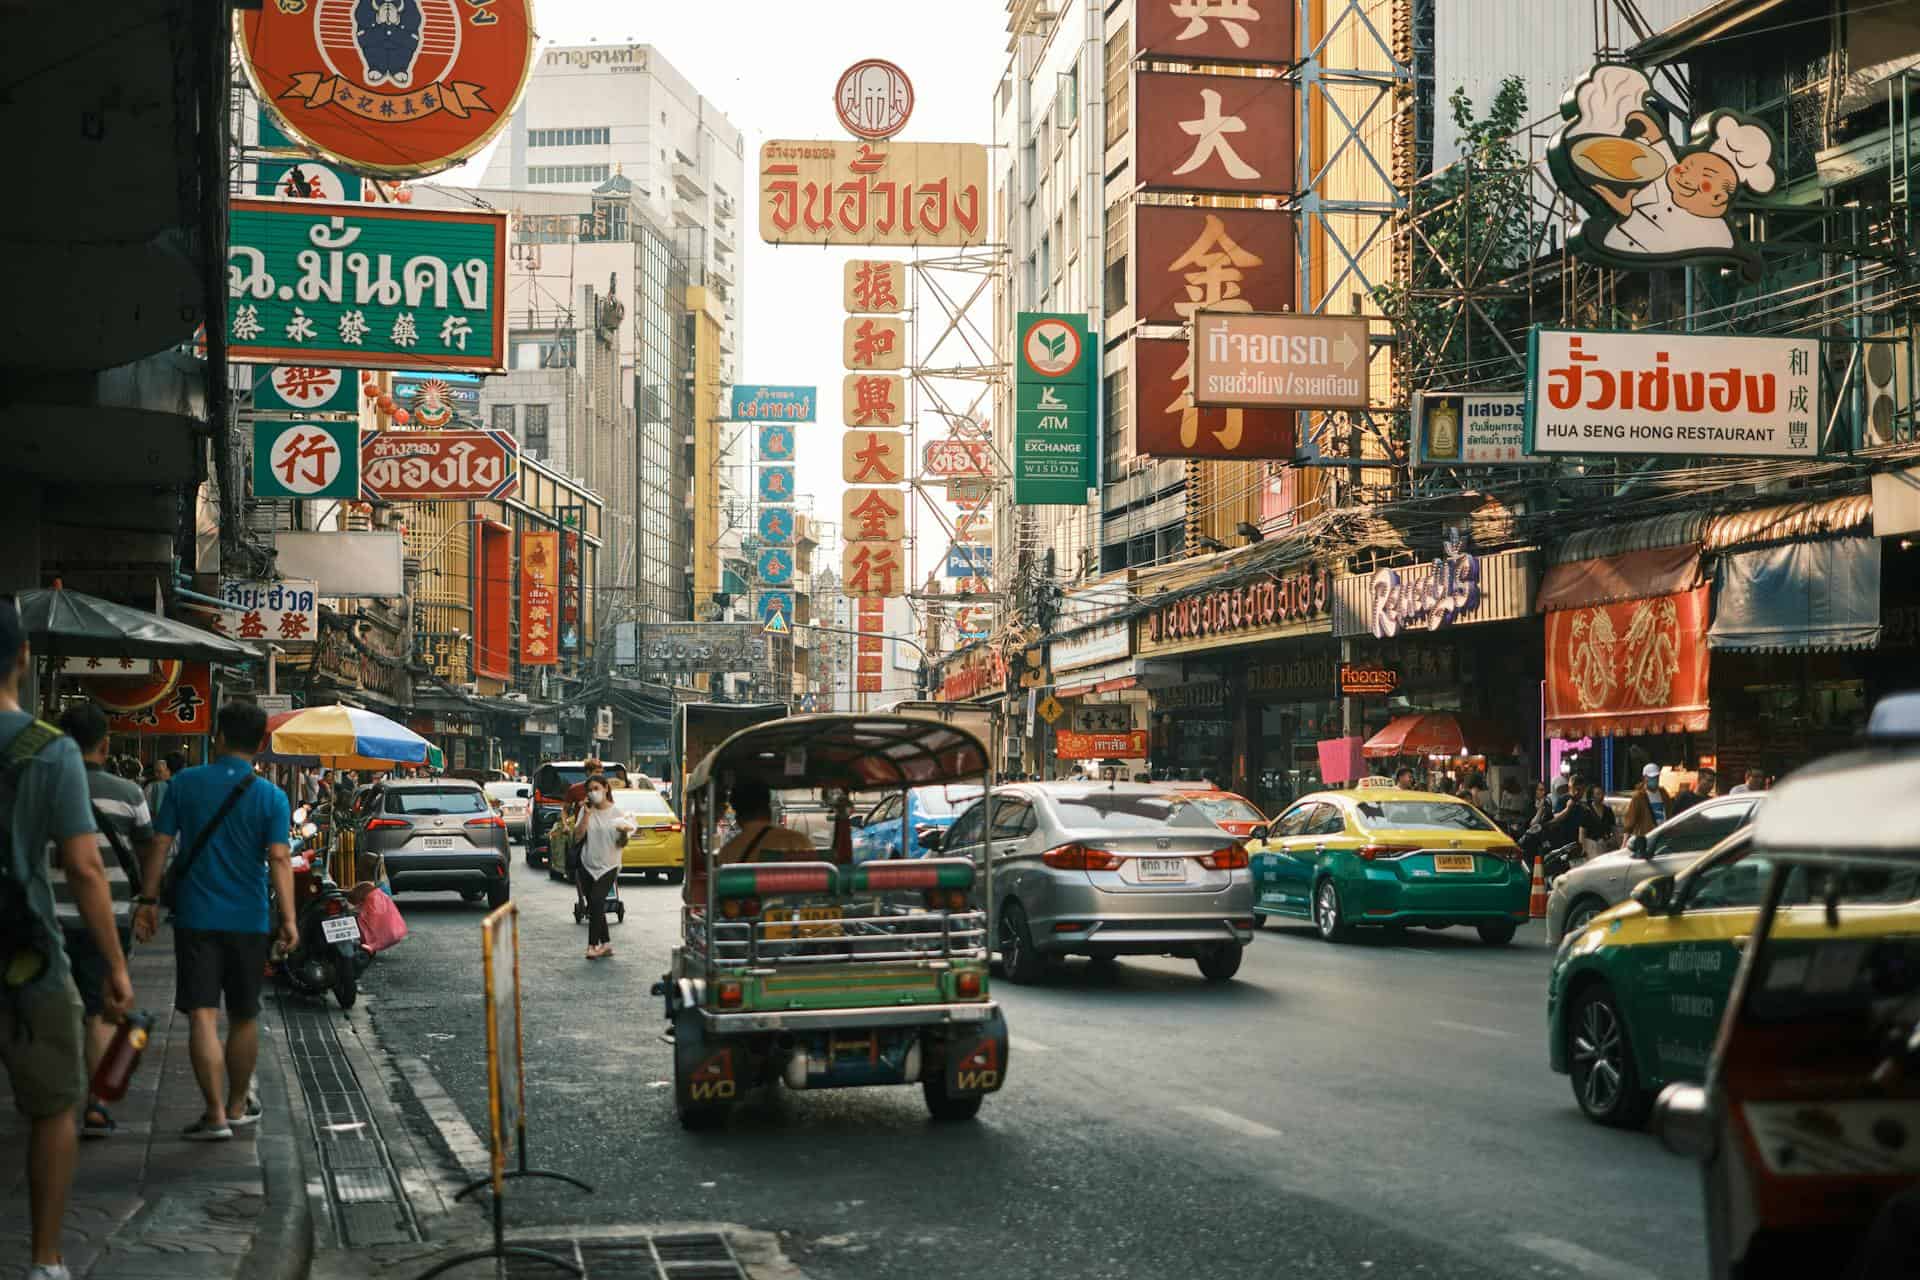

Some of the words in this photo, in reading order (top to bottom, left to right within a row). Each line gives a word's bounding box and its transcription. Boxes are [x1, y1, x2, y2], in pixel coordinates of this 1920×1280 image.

[228, 216, 488, 311] ฉ.มั่นคง
[1209, 320, 1329, 365] ที่จอดรถ
[1786, 347, 1809, 449] 和成豐
[1038, 416, 1068, 429] ATM
[1547, 424, 1578, 437] HUA
[1583, 424, 1625, 438] SENG
[1629, 425, 1673, 439] HONG
[1677, 426, 1775, 442] RESTAURANT
[1024, 444, 1081, 453] EXCHANGE
[1024, 464, 1080, 474] WISDOM
